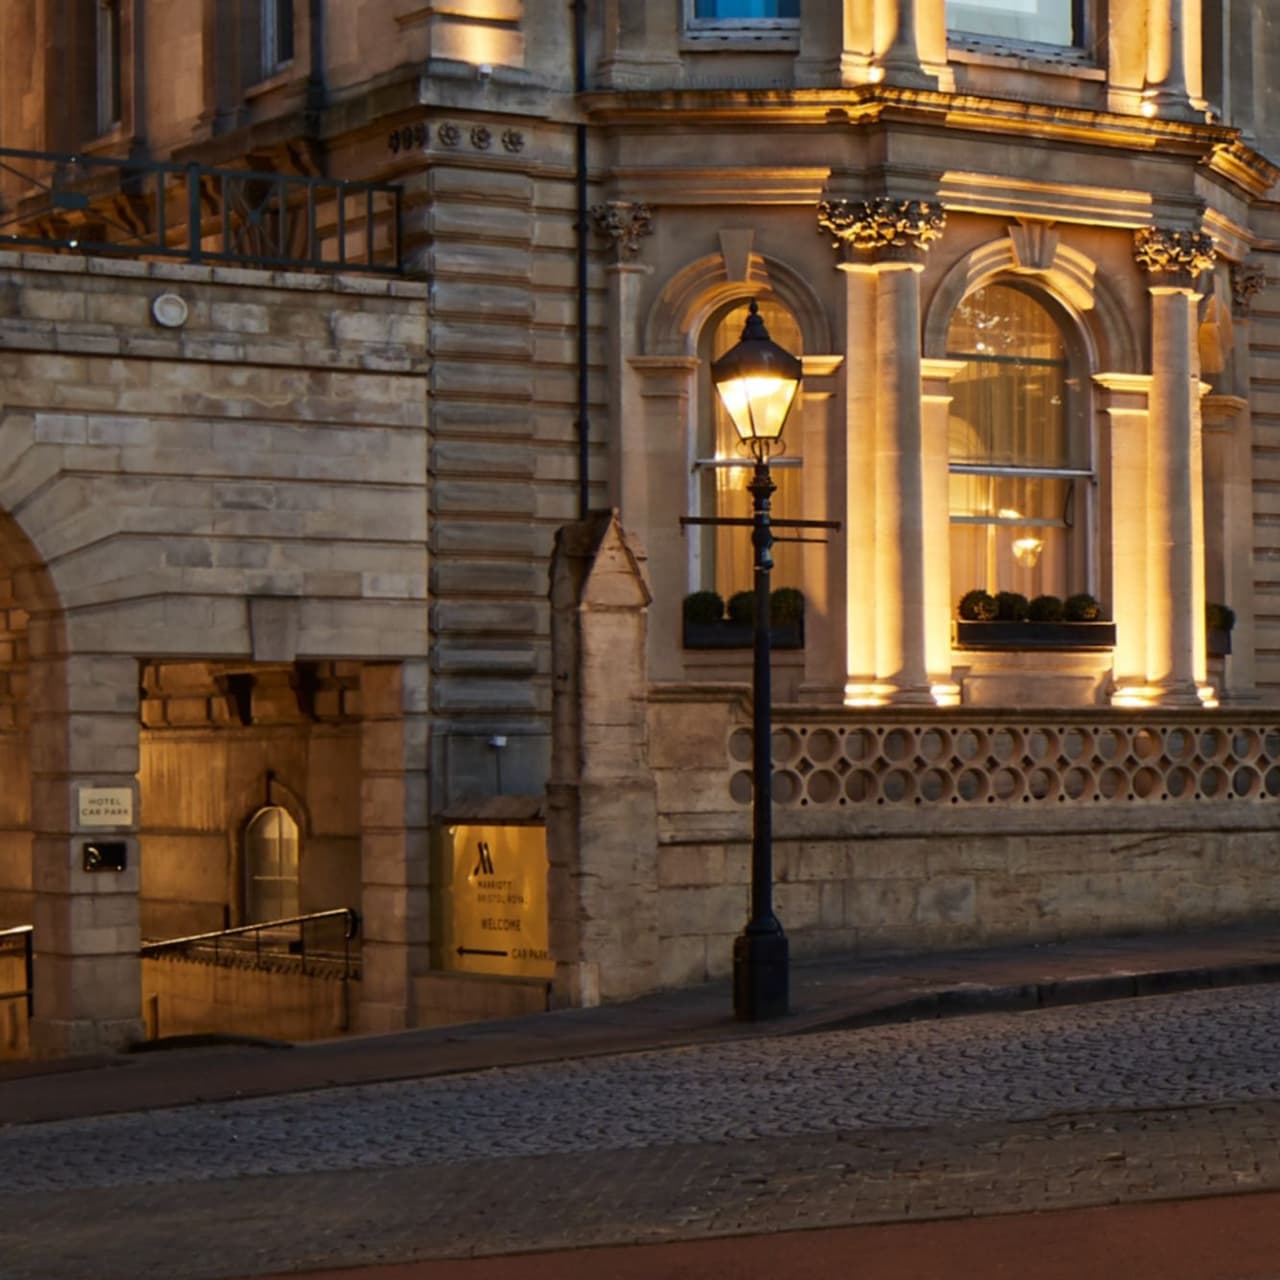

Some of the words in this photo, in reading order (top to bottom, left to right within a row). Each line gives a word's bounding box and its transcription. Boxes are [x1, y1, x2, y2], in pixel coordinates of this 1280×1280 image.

[88, 798, 121, 806] HOTEL
[81, 808, 101, 816] CAR
[104, 808, 128, 816] PARK
[481, 918, 521, 932] WELCOME
